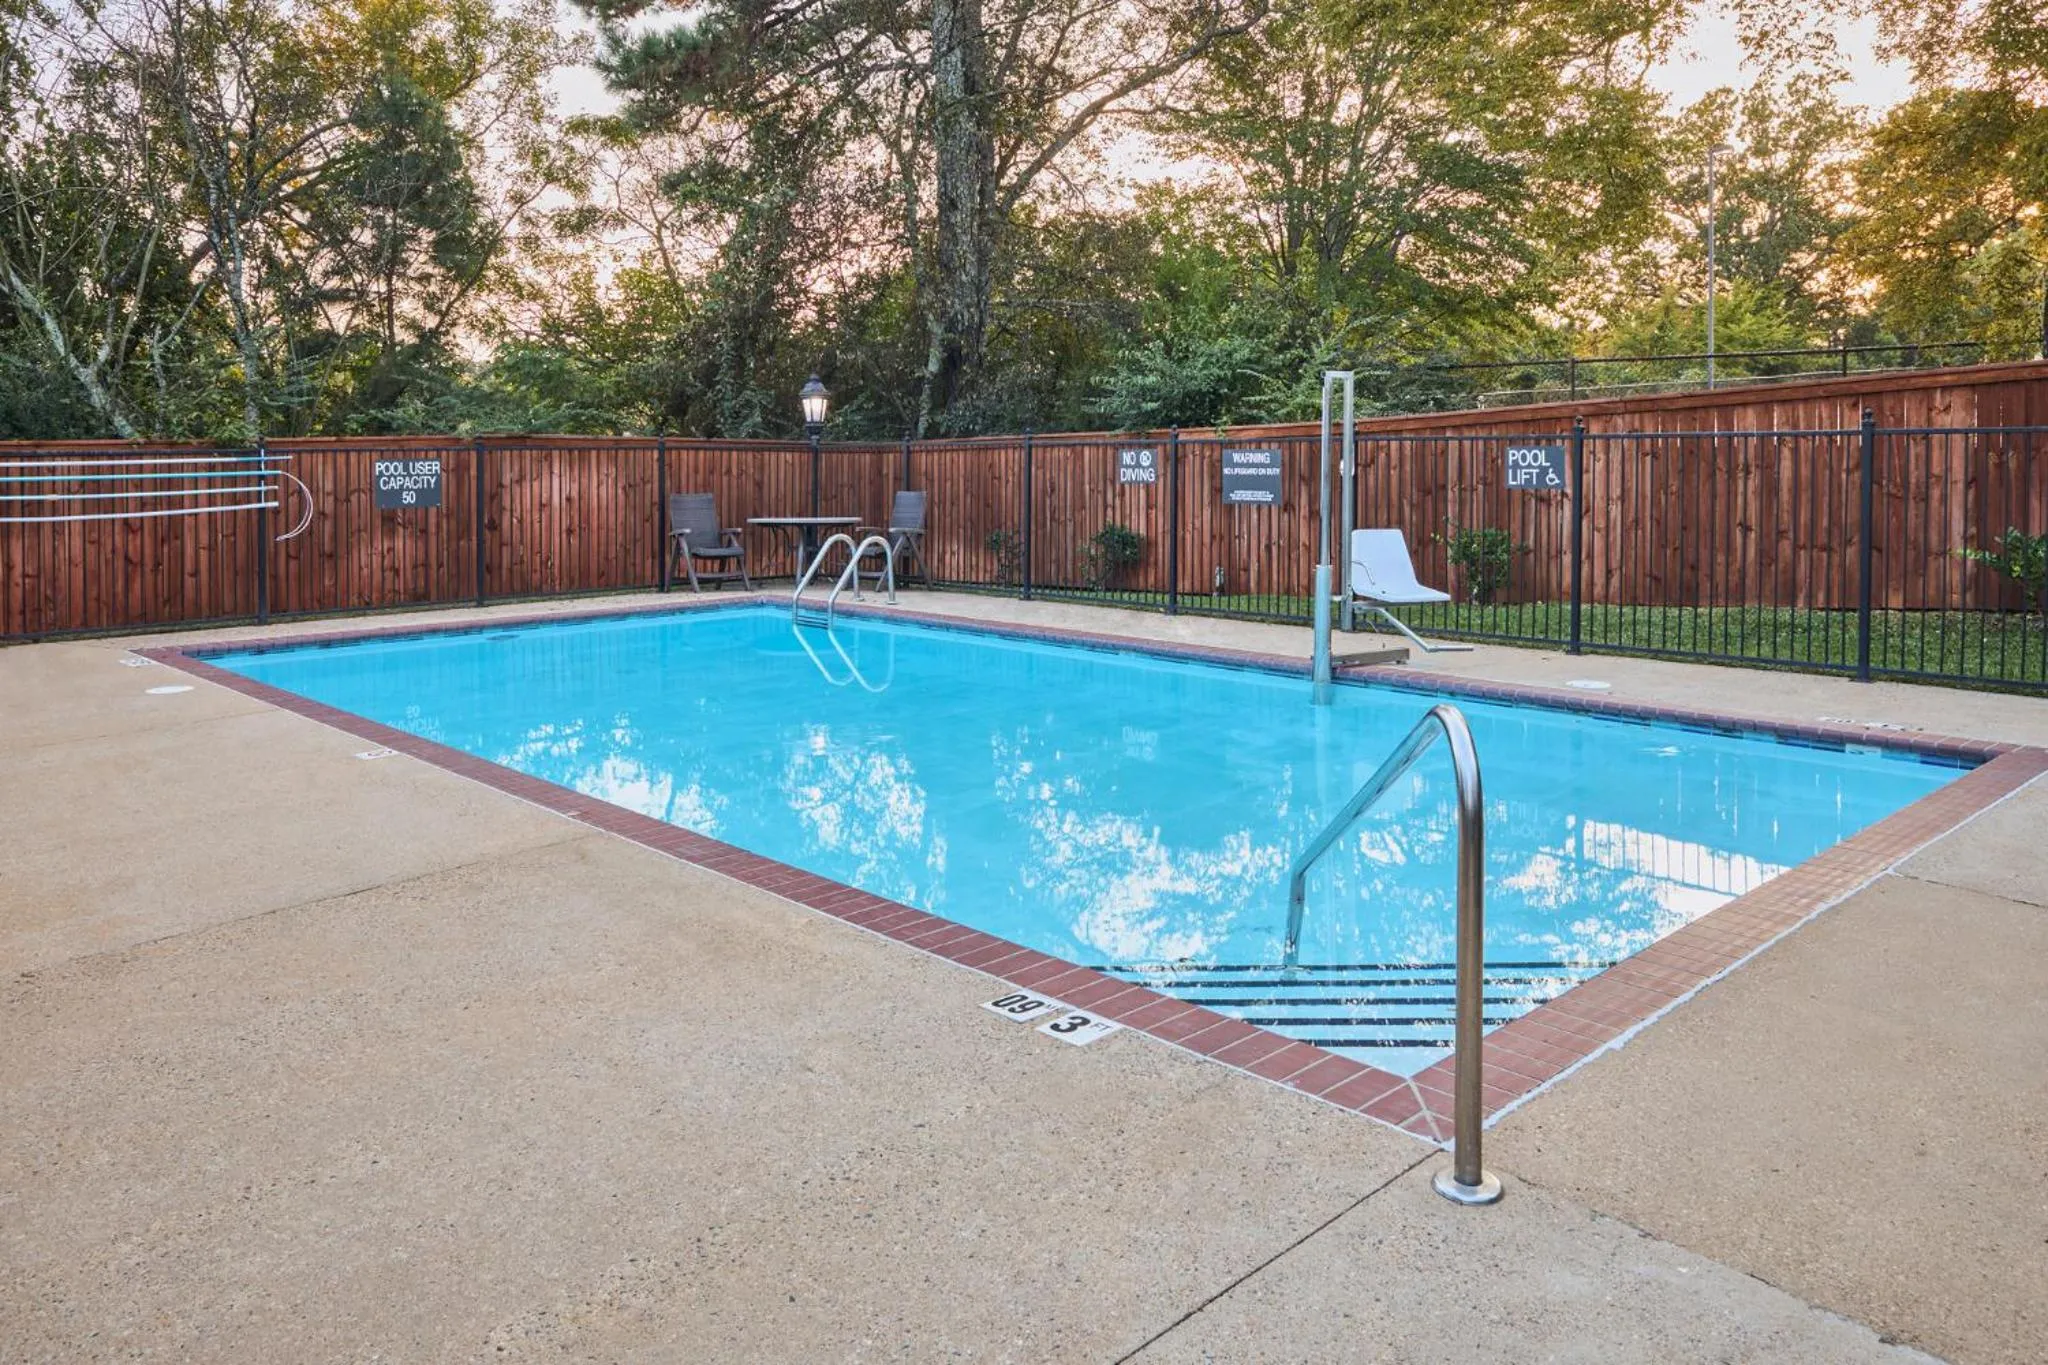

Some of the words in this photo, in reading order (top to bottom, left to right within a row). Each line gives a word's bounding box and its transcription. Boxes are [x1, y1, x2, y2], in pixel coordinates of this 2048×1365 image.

[1123, 451, 1137, 465] NO
[1232, 452, 1271, 464] WARNING
[1508, 449, 1551, 466] POOL
[375, 462, 407, 475] POOL
[409, 461, 440, 475] USER
[1120, 468, 1155, 482] DIVING
[380, 476, 436, 490] CAPACITY
[1508, 469, 1540, 485] LIFT
[402, 491, 416, 504] 50
[1049, 1016, 1092, 1033] 3
